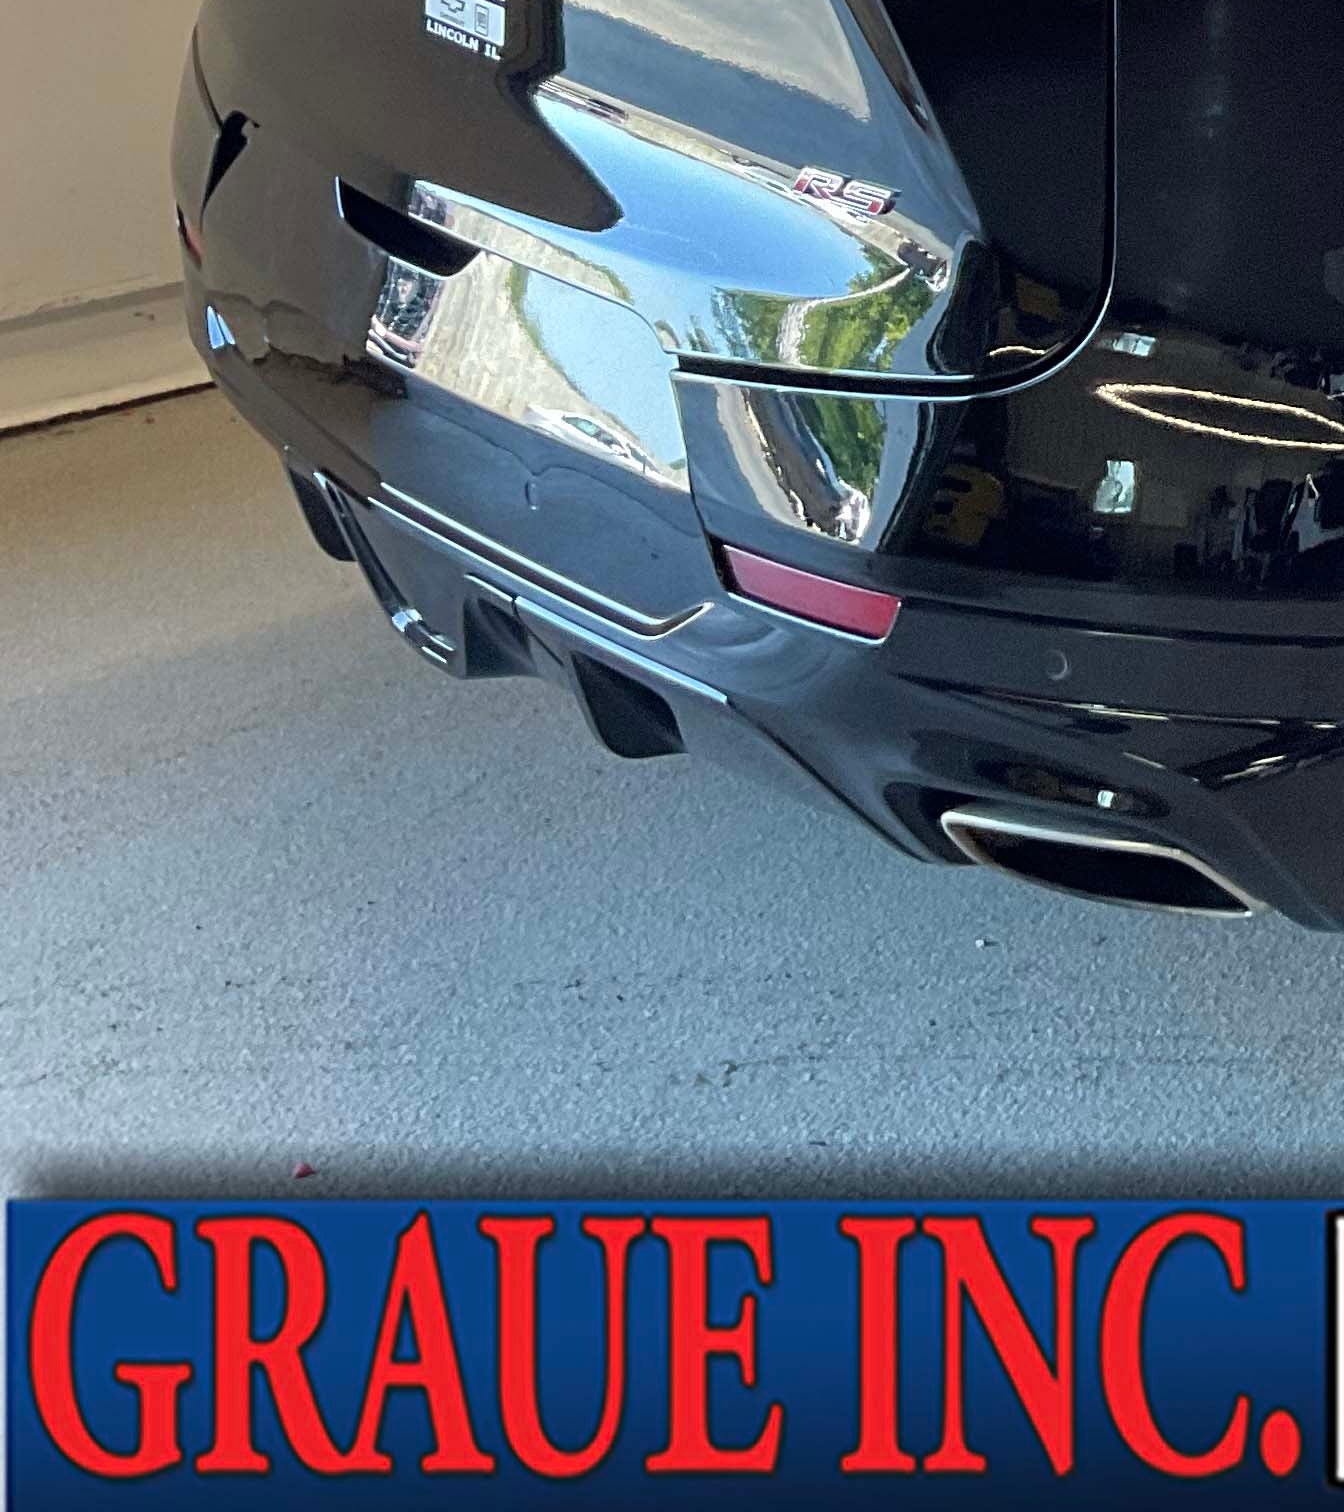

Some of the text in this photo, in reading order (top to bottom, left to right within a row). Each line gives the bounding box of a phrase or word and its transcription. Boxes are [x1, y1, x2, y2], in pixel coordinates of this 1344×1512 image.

[425, 18, 480, 51] LINCOLN
[484, 43, 501, 61] IL
[792, 165, 901, 216] RS
